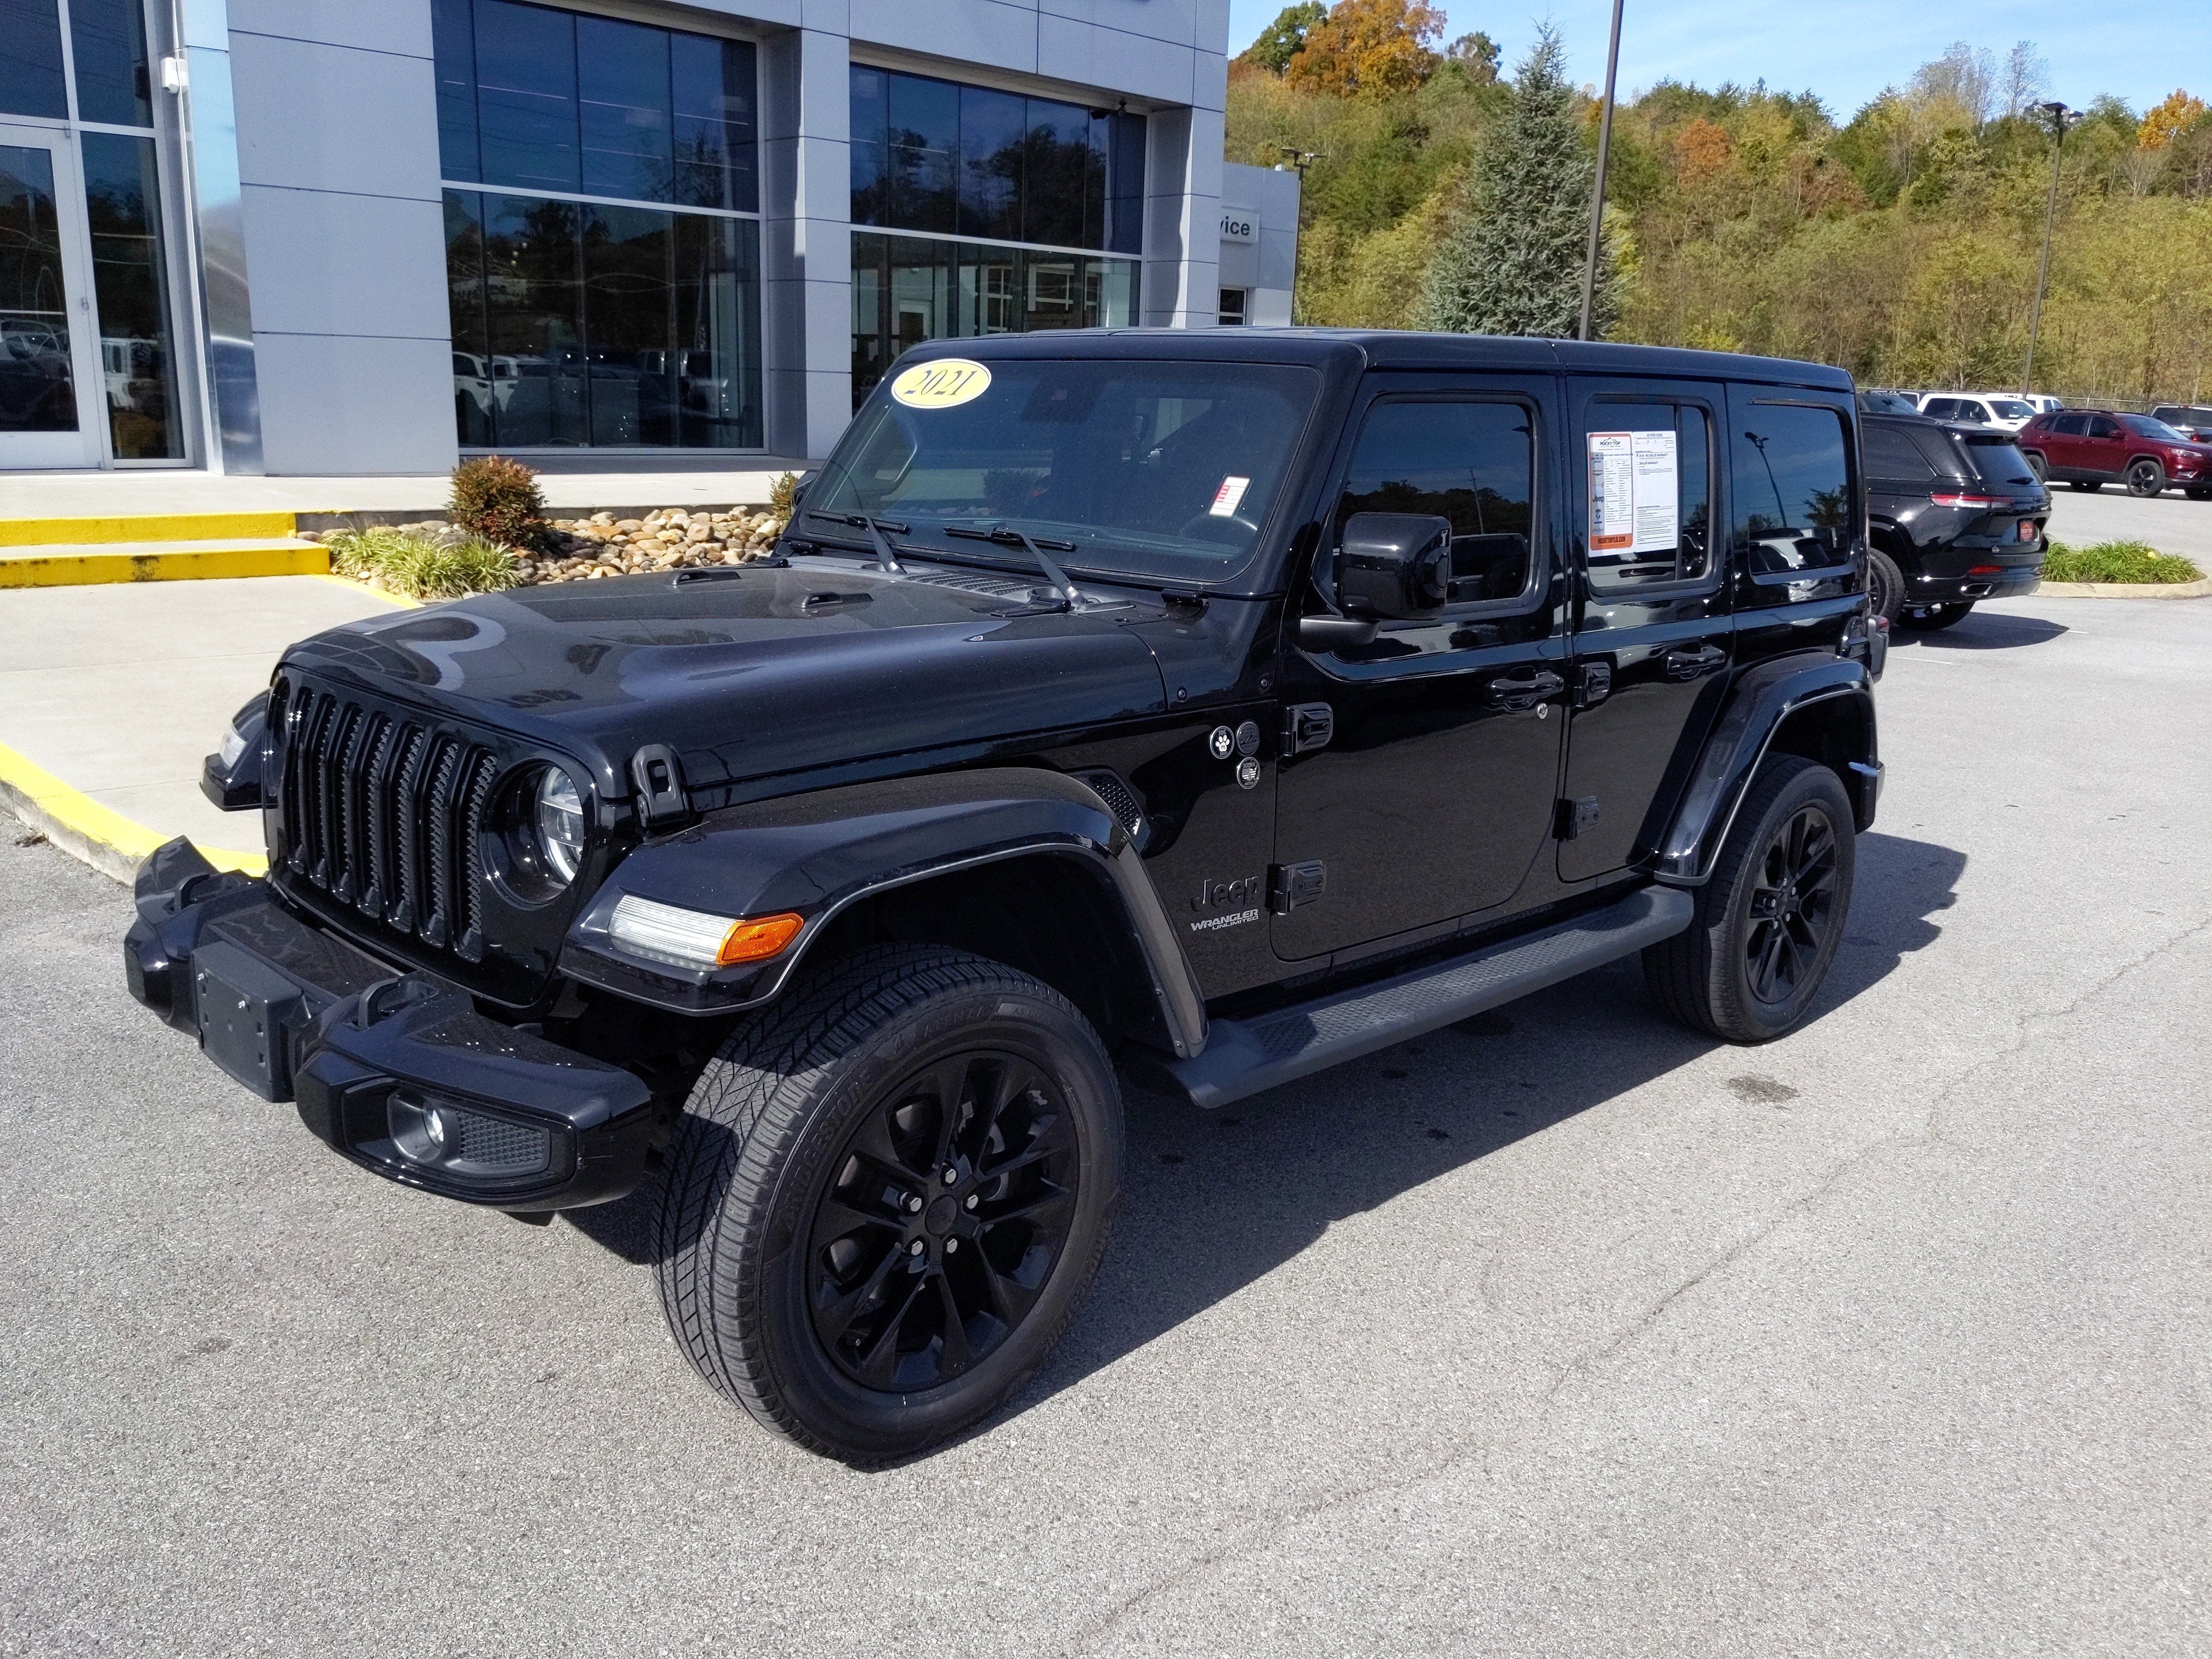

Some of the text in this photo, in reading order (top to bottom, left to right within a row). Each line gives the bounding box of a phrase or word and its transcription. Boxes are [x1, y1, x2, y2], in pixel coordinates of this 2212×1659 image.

[904, 369, 978, 396] 2021
[1593, 495, 1604, 503] Jeep
[1190, 876, 1261, 912] Jeep
[1190, 909, 1259, 931] WRANGLER
[1212, 916, 1259, 930] UNLIMITED
